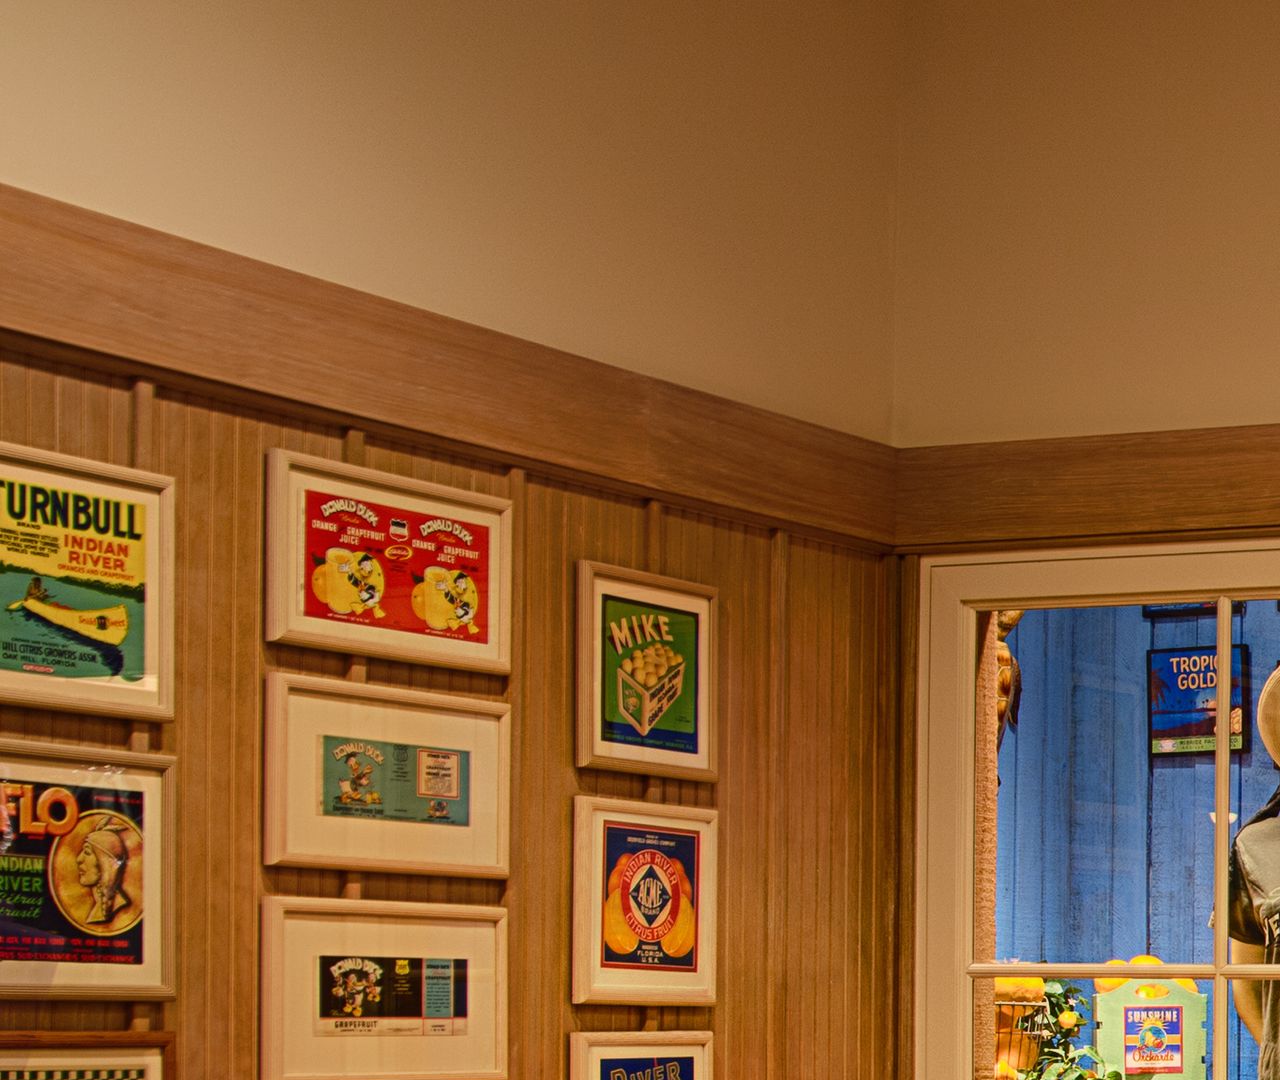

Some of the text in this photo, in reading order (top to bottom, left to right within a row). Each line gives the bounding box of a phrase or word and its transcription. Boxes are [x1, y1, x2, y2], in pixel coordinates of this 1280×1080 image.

[312, 519, 386, 543] ORANGE GRAPEFRUIT
[338, 534, 360, 546] JUICE
[63, 533, 129, 558] INDIAN
[68, 551, 126, 573] RIVER
[609, 614, 674, 656] MIKE
[1177, 673, 1217, 690] GOLD
[624, 852, 679, 885] INDIAN RIVER
[638, 877, 663, 909] ACME
[625, 912, 676, 940] CITRUS FRUIT
[335, 1020, 378, 1029] GRAPEFRUIT
[1127, 1010, 1178, 1023] SUNSHINE
